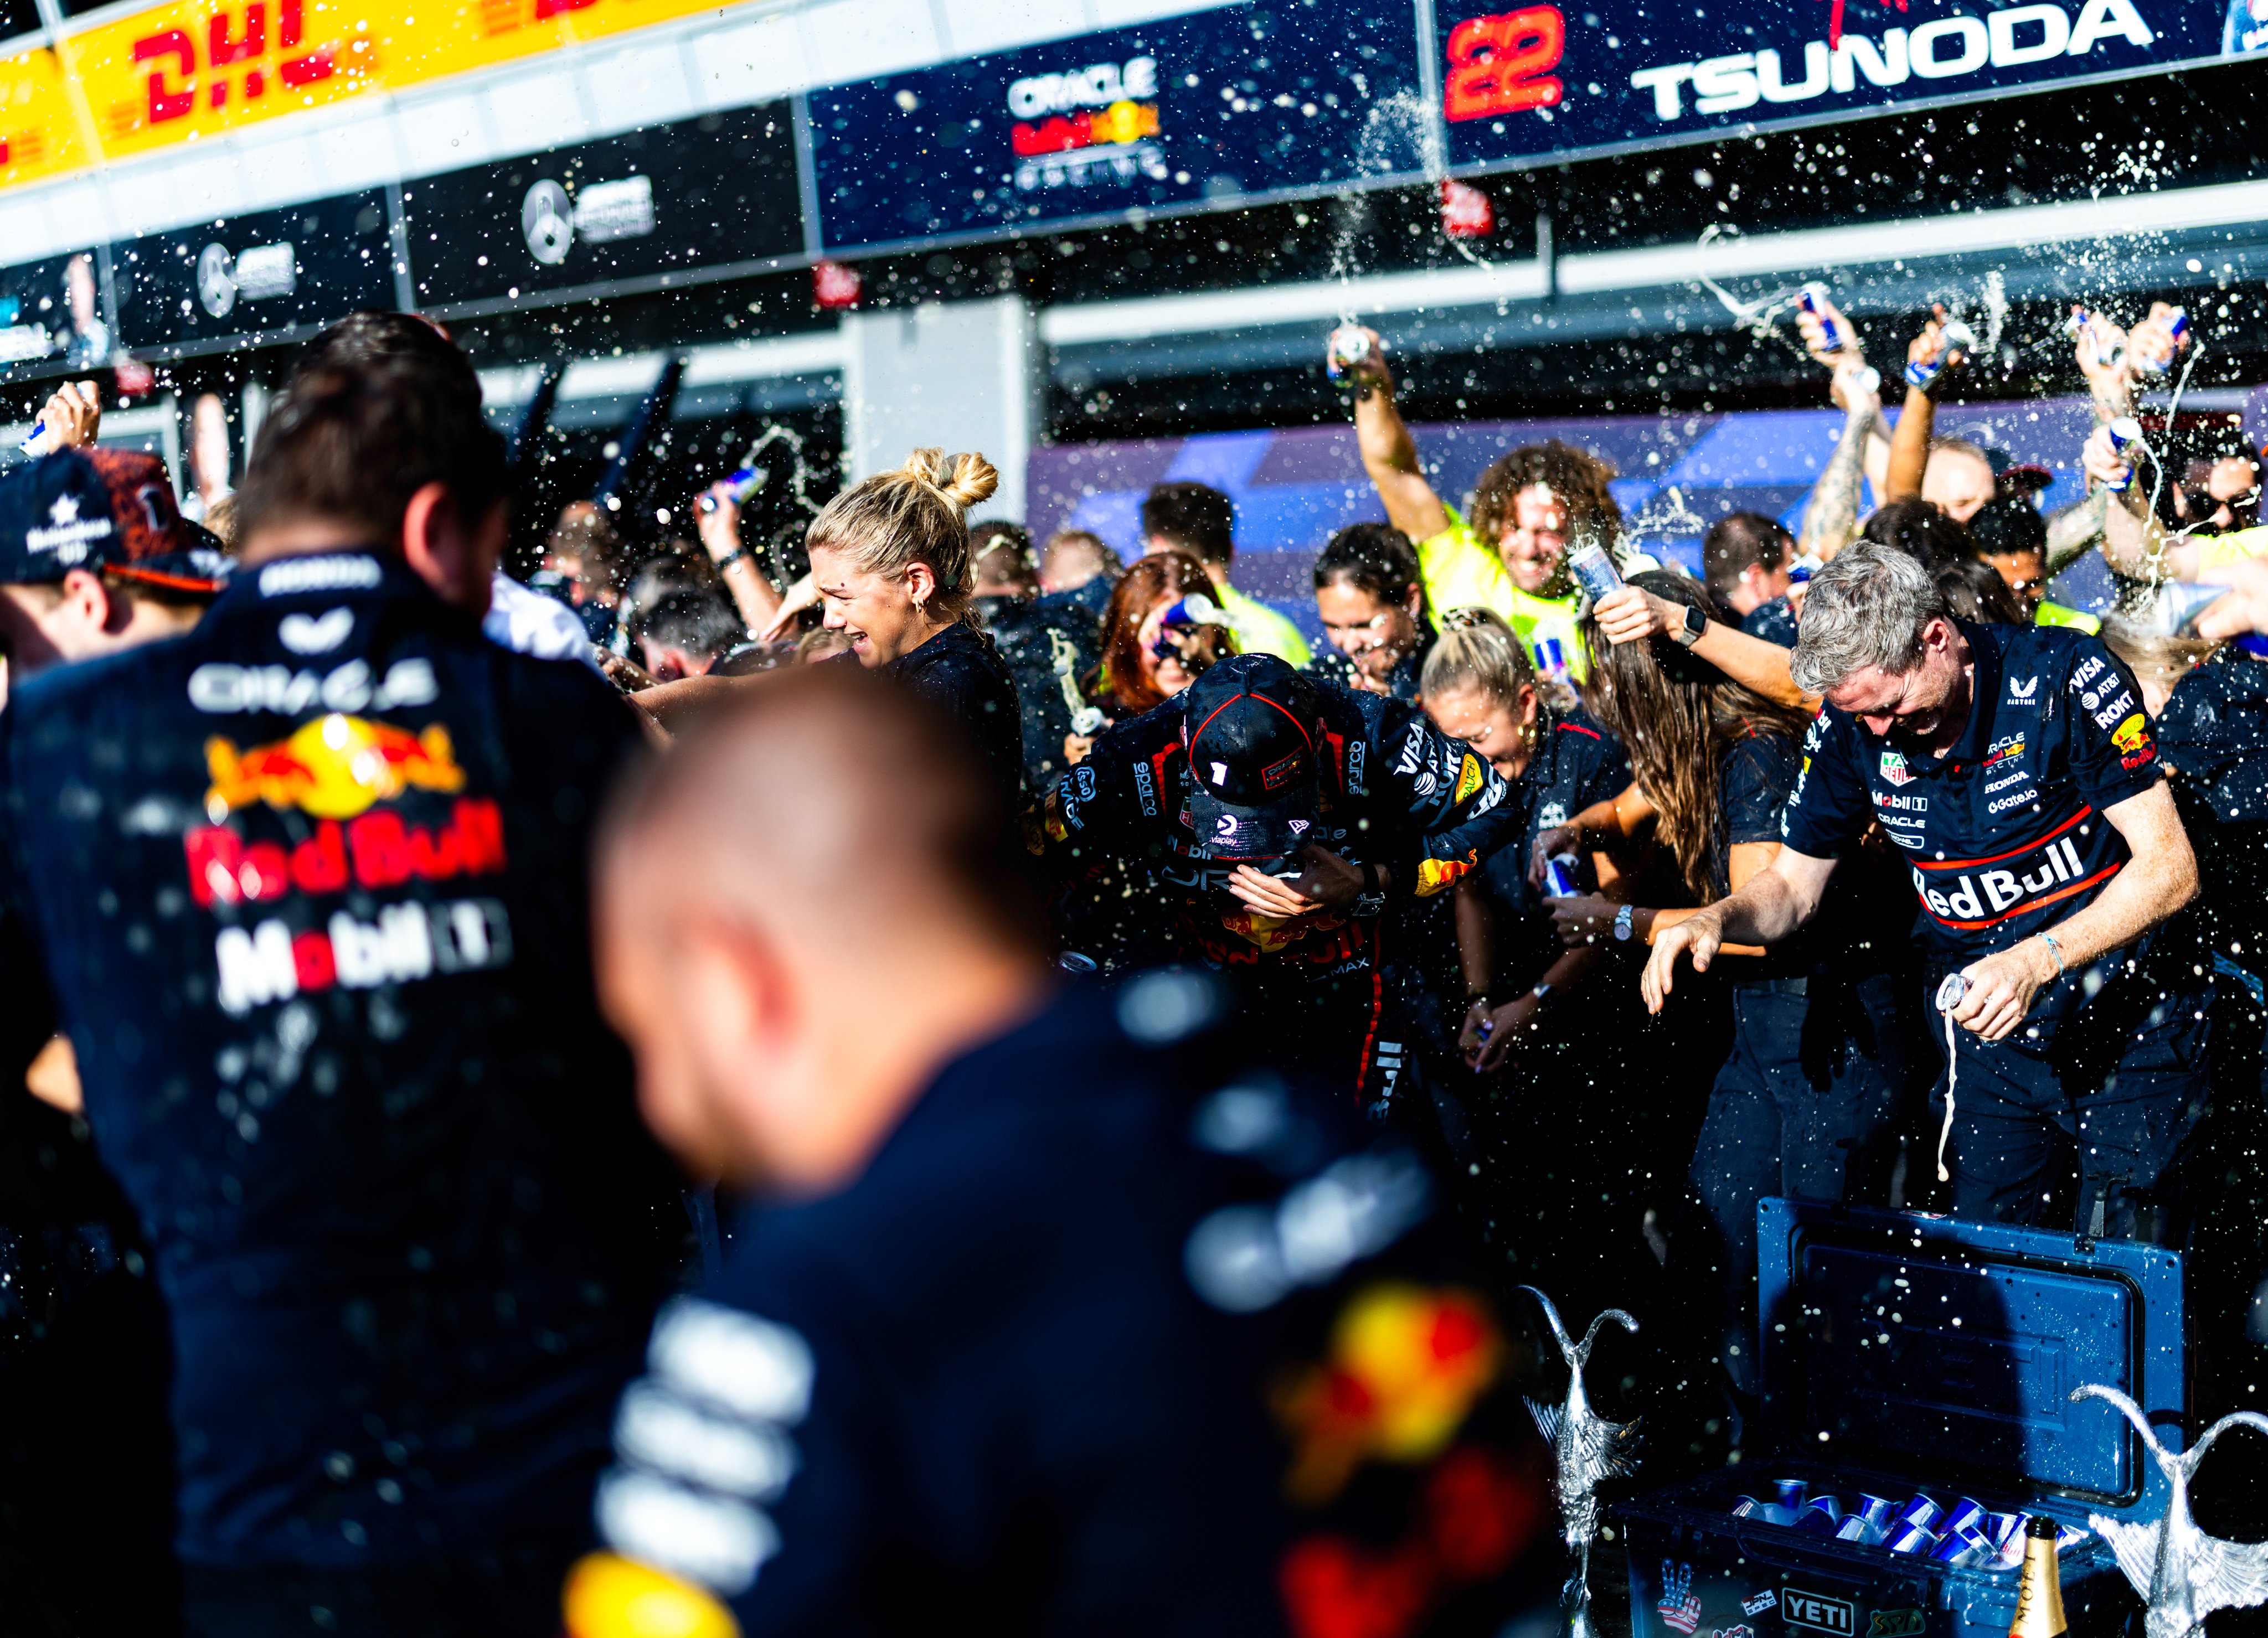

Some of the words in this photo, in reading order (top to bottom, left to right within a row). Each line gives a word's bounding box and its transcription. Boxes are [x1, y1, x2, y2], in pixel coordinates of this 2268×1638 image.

[133, 0, 339, 124] DHL
[1444, 4, 1565, 123] 22
[1630, 0, 2155, 121] TSUNODA
[2069, 657, 2105, 689] VISA
[2097, 673, 2120, 697] AT&T
[2095, 690, 2134, 730] ROKT
[2122, 717, 2143, 738] RAUCH
[1393, 722, 1425, 775] VISA
[1884, 755, 1905, 767] TA
[1986, 753, 2024, 776] RCING
[1210, 761, 1228, 786] 1
[1883, 767, 1909, 783] HEU
[1984, 771, 2029, 794] HONDA
[1135, 762, 1157, 817] sparco
[1872, 791, 1911, 810] Mobil
[1878, 813, 1926, 829] ORACLE
[1211, 835, 1237, 846] viaplay
[1913, 866, 1984, 919] Red
[1979, 836, 2084, 913] Bull
[216, 898, 435, 1017] Mobil
[1331, 957, 1370, 976] MAX
[1747, 1600, 1775, 1614] SPEC
[1787, 1595, 1847, 1629] YETI
